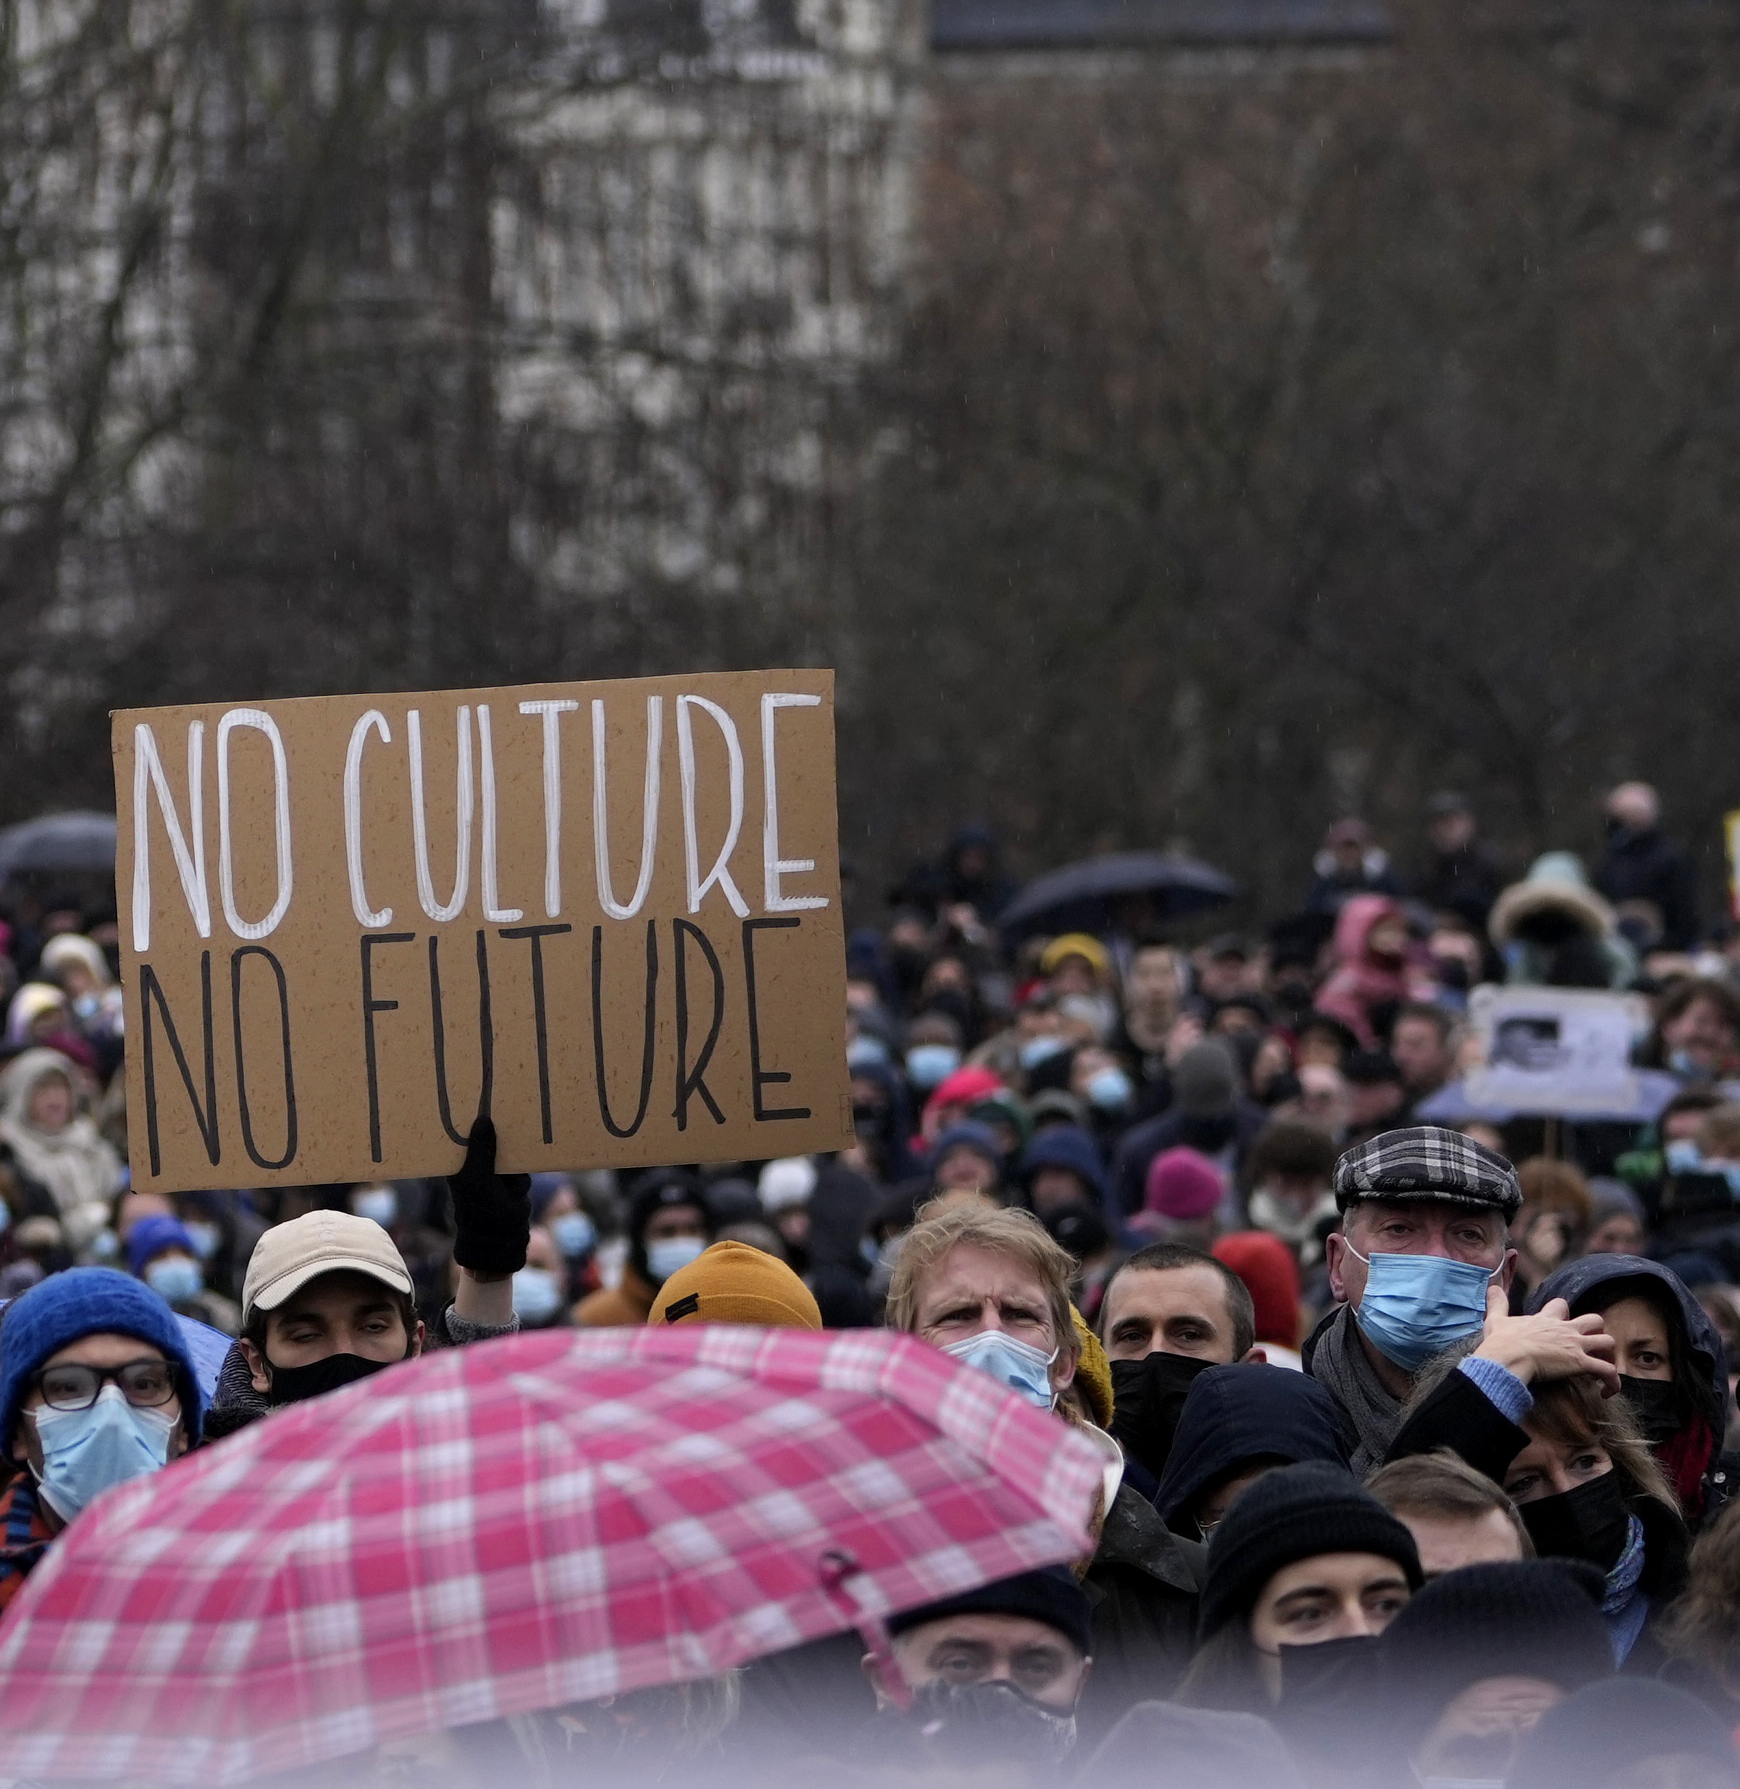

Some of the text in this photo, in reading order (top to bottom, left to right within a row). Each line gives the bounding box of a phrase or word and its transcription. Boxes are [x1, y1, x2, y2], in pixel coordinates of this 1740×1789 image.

[132, 692, 830, 953] NO CULTURE
[139, 916, 812, 1178] NO FUTURE
